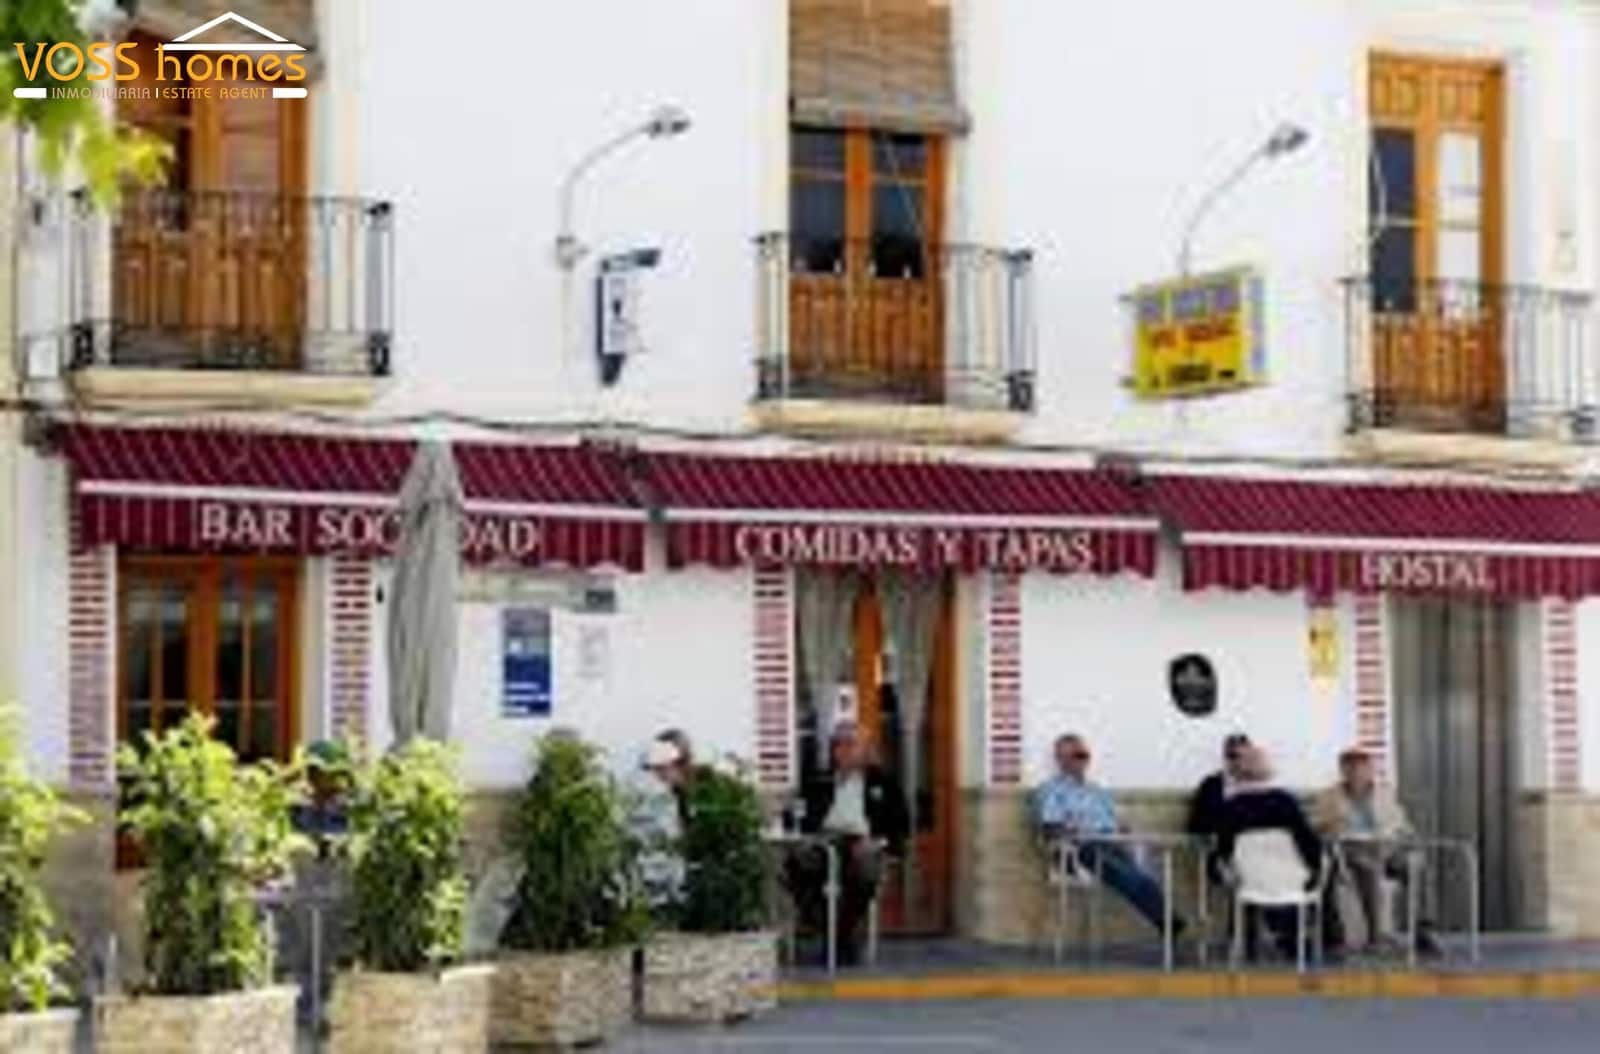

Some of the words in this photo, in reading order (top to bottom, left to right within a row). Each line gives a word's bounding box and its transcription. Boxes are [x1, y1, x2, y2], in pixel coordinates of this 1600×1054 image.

[201, 503, 292, 545] BAR
[735, 525, 917, 564] COMIDAS
[937, 530, 961, 565] Y
[984, 530, 1093, 568] TAPAS
[1361, 554, 1496, 590] HOSTAL
